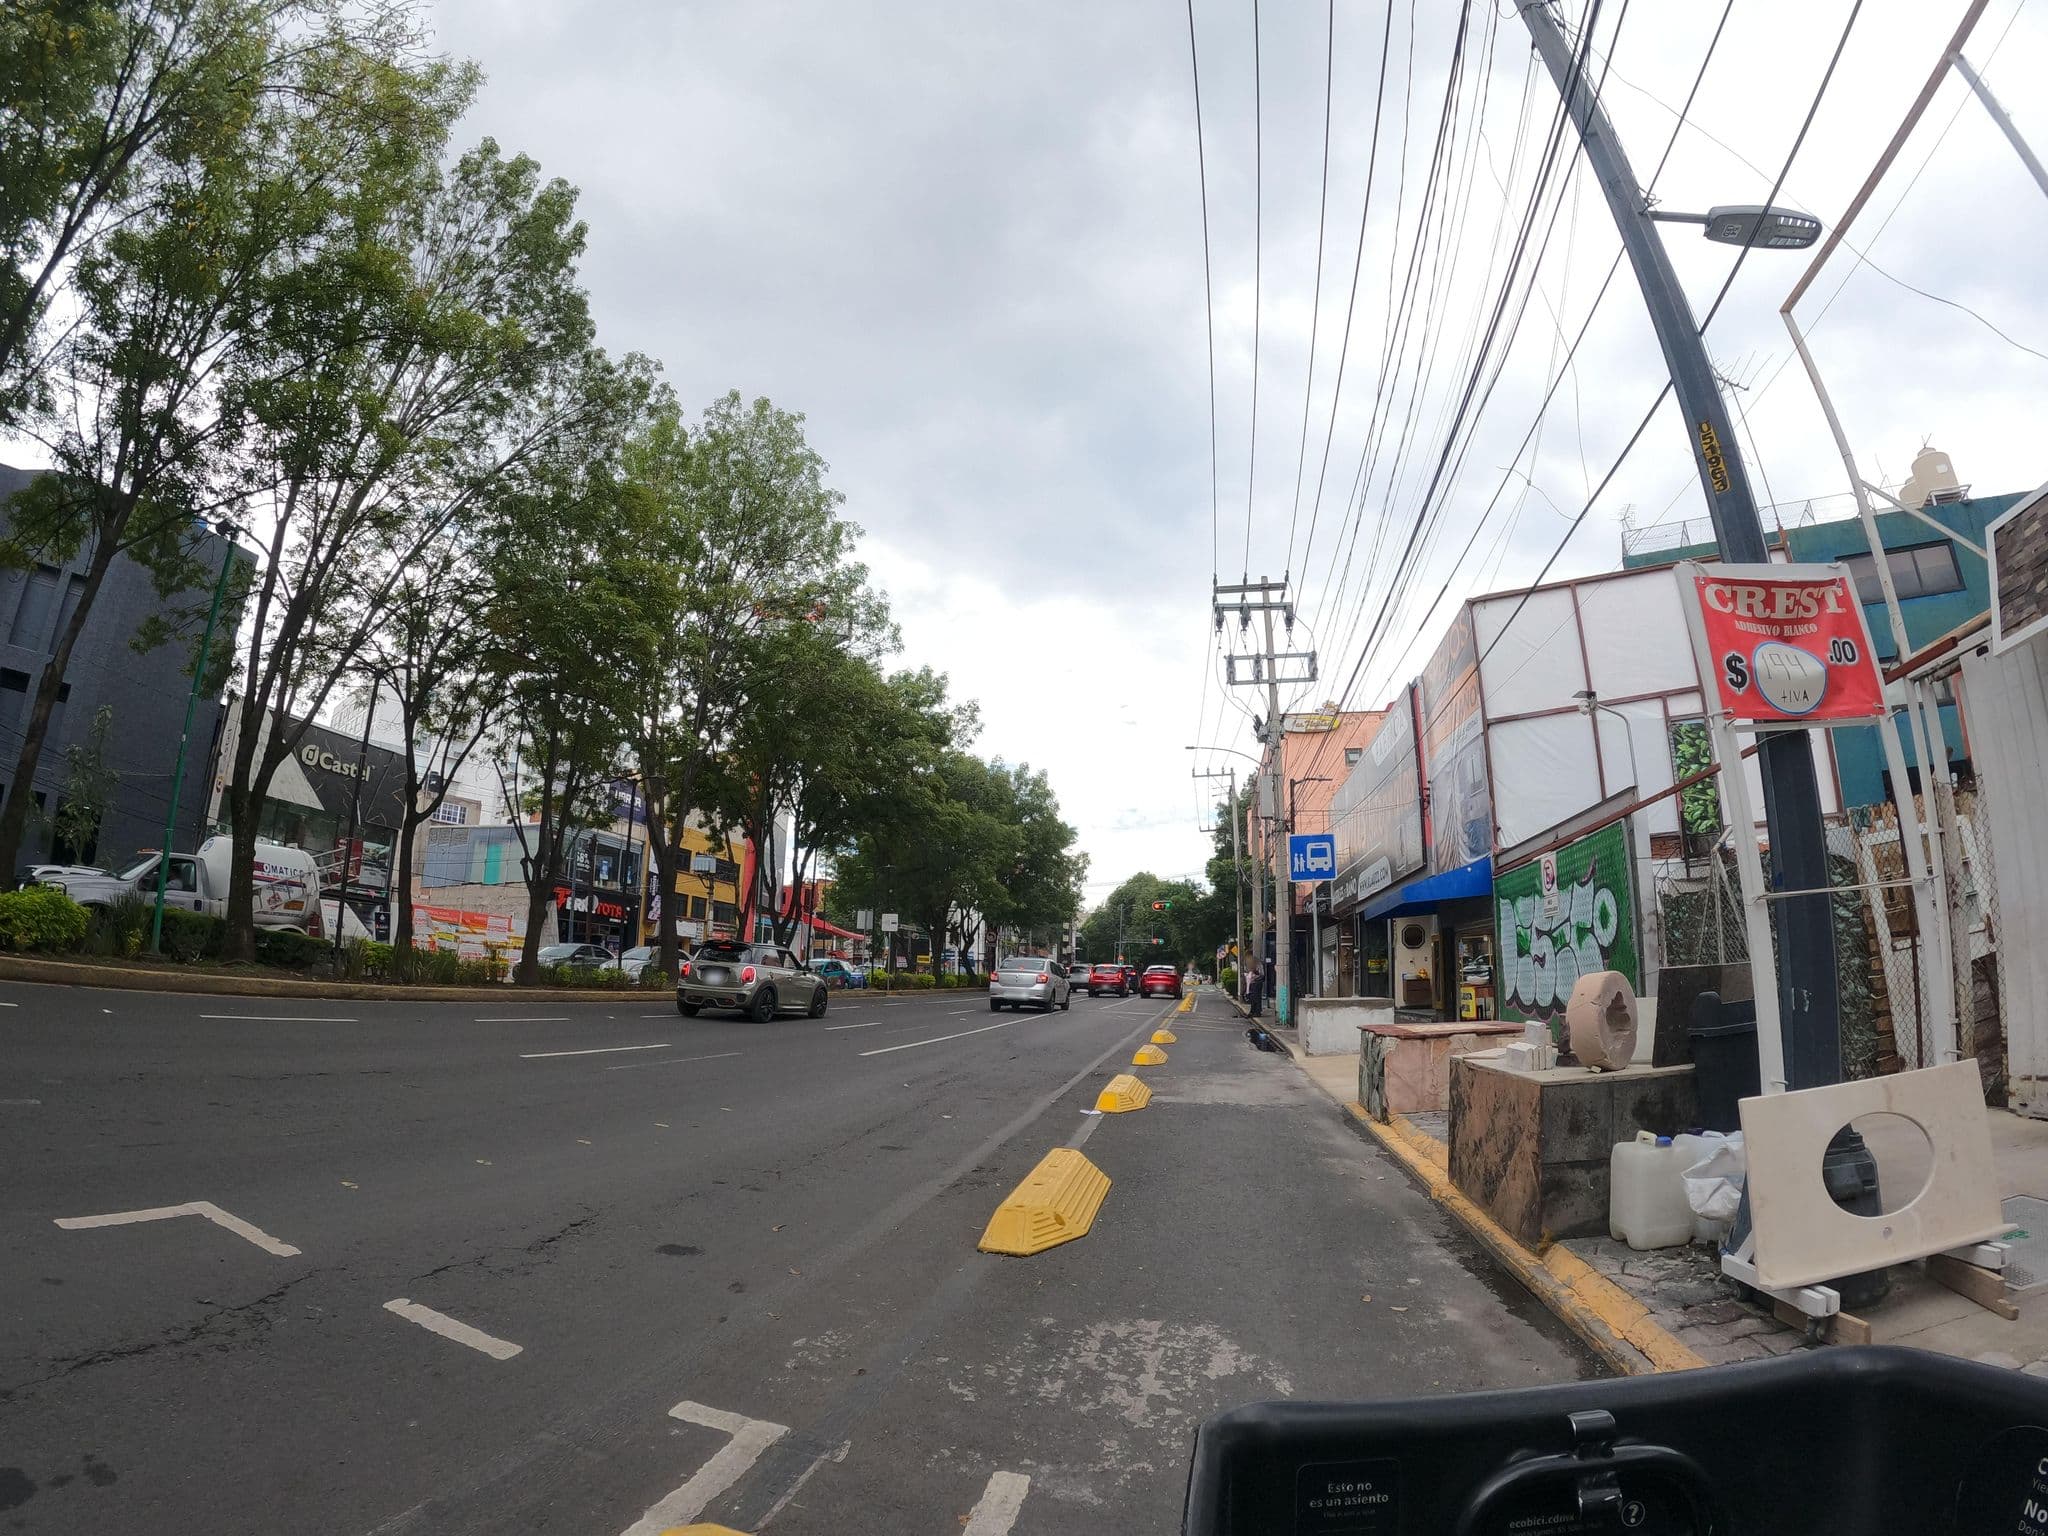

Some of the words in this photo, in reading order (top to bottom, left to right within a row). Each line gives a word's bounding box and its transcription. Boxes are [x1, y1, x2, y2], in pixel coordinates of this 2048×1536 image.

[1705, 583, 1847, 620] CREST
[1734, 620, 1780, 637] ADHESIVO
[1783, 622, 1818, 637] BLANCO
[1761, 652, 1808, 680] 194
[1327, 1483, 1354, 1493] Esto
[1357, 1482, 1372, 1491] no
[1309, 1499, 1323, 1508] es
[1326, 1498, 1341, 1507] un
[1344, 1493, 1389, 1506] asiento
